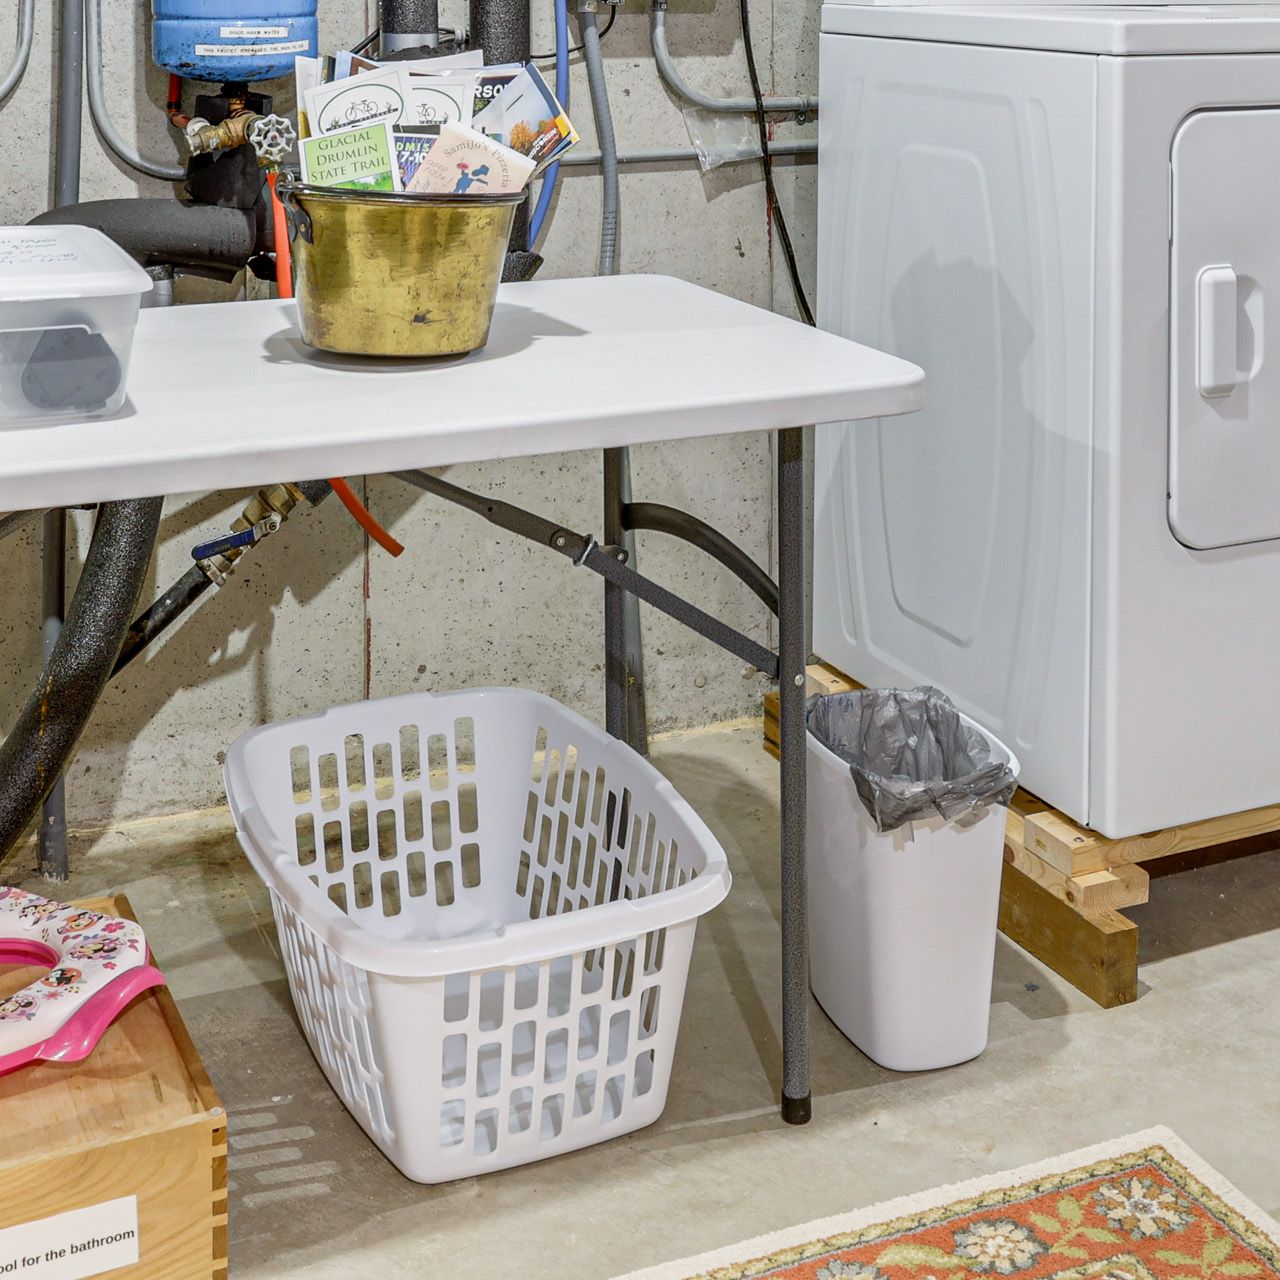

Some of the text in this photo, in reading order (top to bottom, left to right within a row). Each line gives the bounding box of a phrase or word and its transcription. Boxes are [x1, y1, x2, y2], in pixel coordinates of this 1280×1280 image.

[475, 84, 504, 98] RSO
[318, 131, 372, 151] GLACIAL
[396, 141, 430, 151] DMIS
[316, 143, 378, 166] DRUMLIN
[311, 156, 387, 182] STATE TRAIL
[491, 147, 513, 188] Pizzeria
[21, 1255, 41, 1269] for
[45, 1247, 66, 1263] the
[70, 1229, 135, 1255] bathroom
